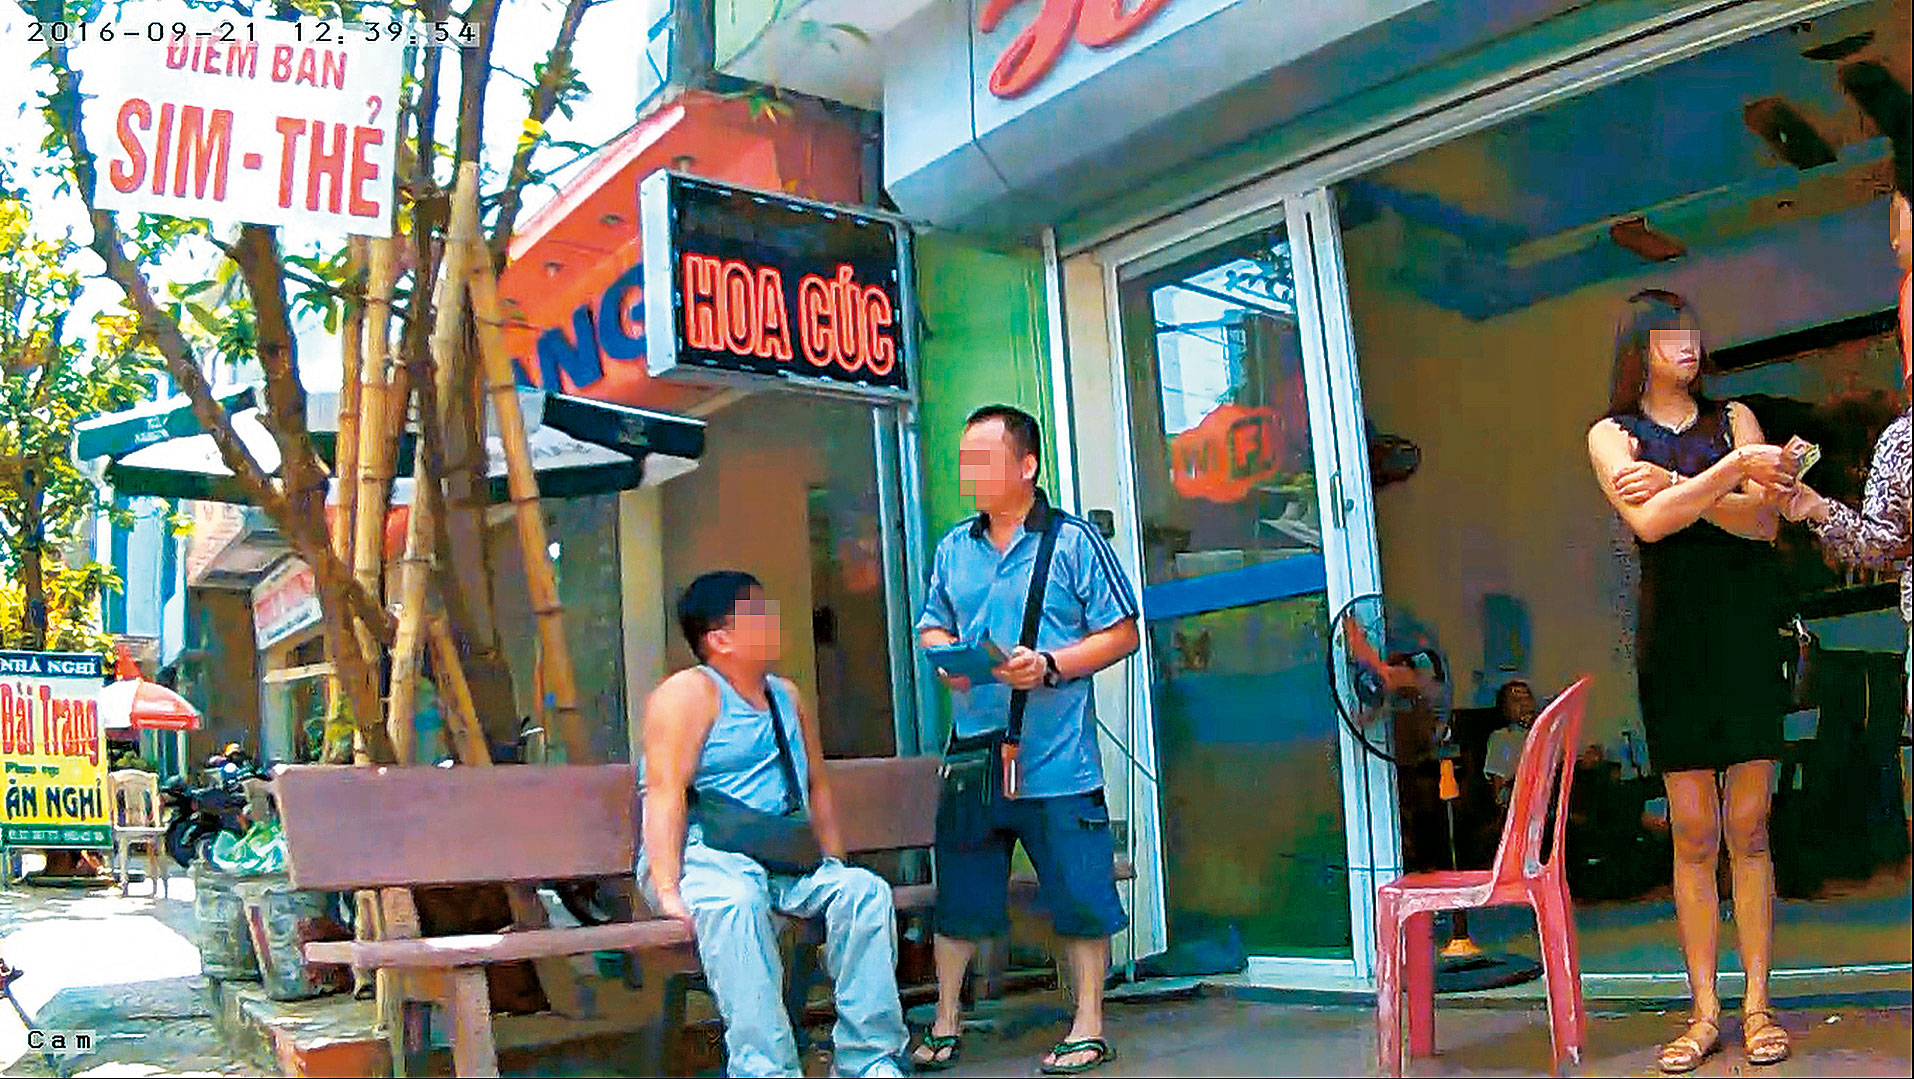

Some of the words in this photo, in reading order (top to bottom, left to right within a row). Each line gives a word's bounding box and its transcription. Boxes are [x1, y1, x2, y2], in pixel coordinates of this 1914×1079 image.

[275, 95, 385, 219] THẺ
[512, 262, 647, 397] NG
[682, 253, 793, 361] HOA
[800, 264, 895, 375] CÚC
[39, 684, 99, 767] Trang
